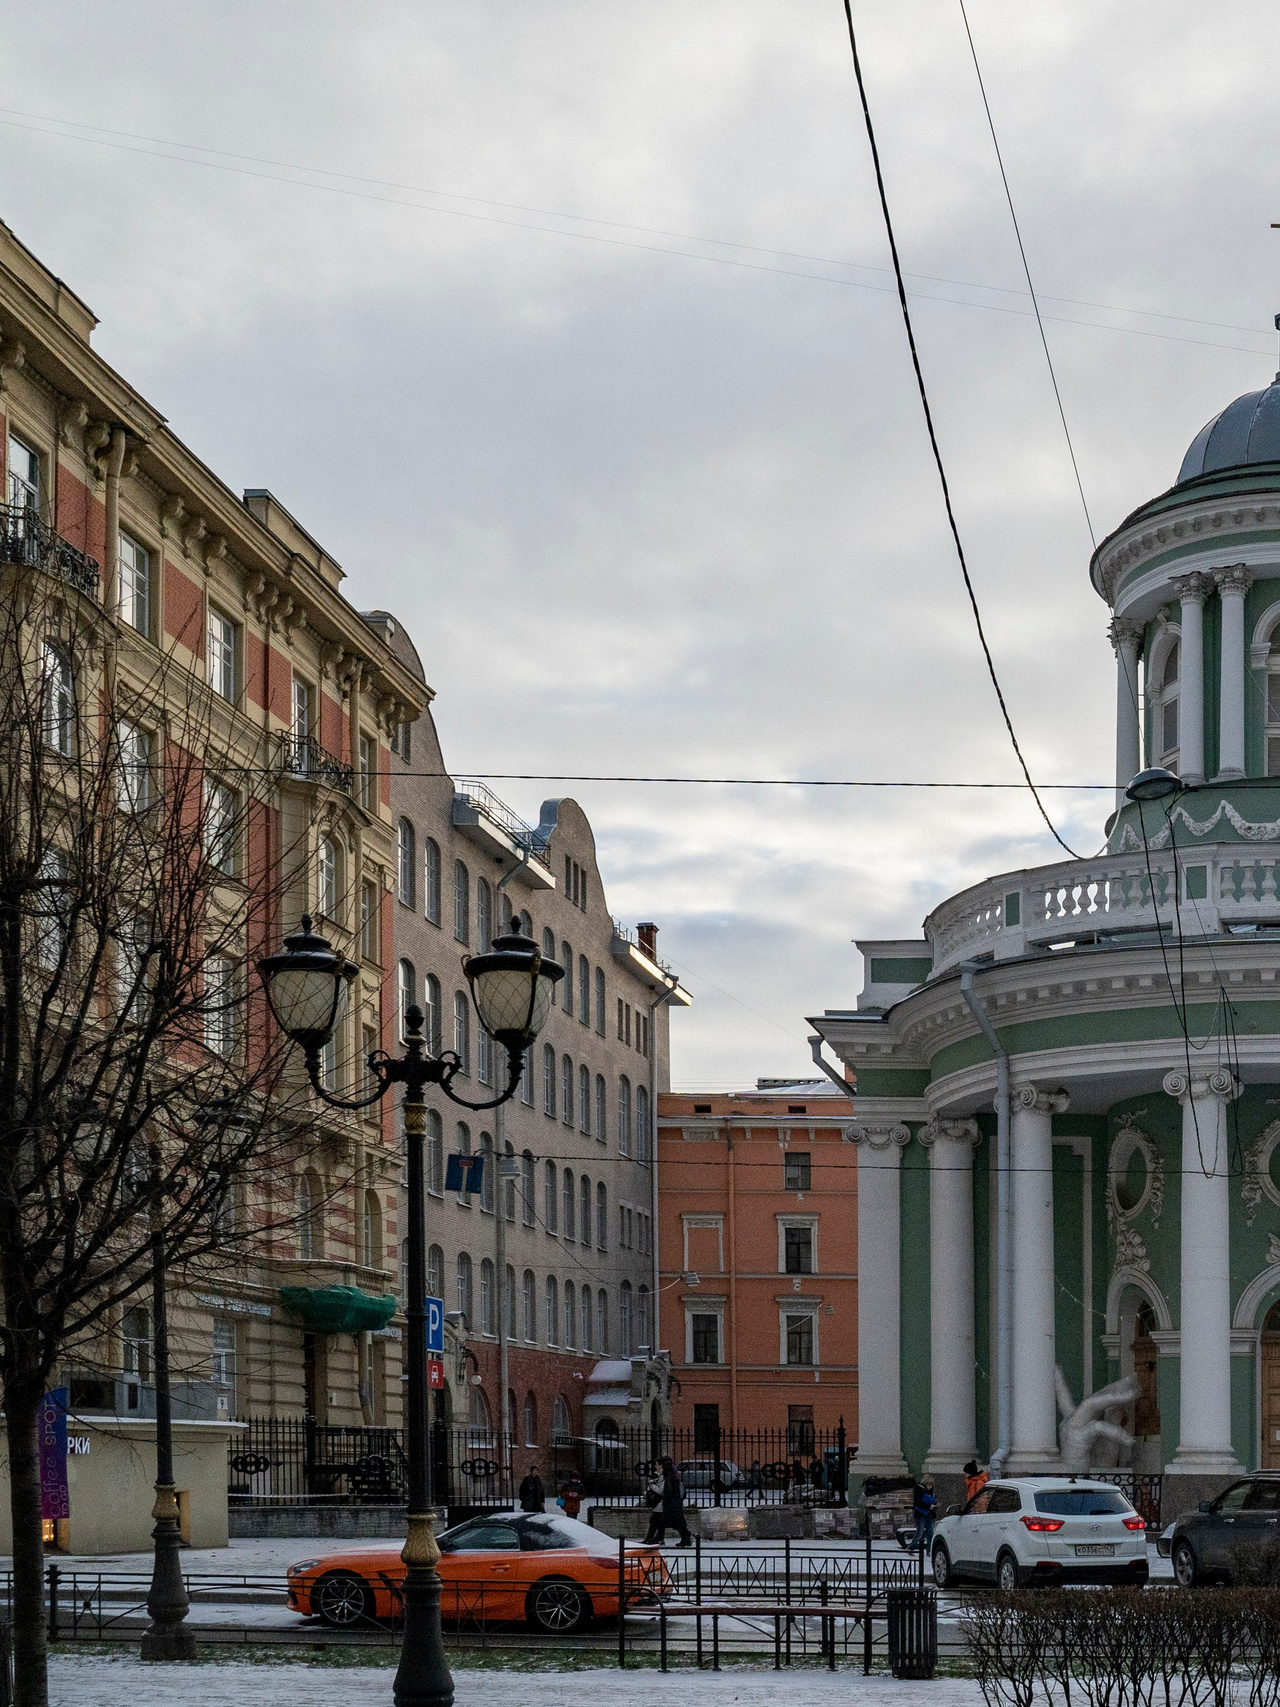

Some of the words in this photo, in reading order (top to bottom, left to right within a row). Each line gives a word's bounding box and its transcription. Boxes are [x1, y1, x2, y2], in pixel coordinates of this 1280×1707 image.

[429, 1303, 440, 1345] P
[44, 1400, 57, 1445] SPOT
[59, 1485, 68, 1501] GO
[61, 1503, 69, 1516] TO
